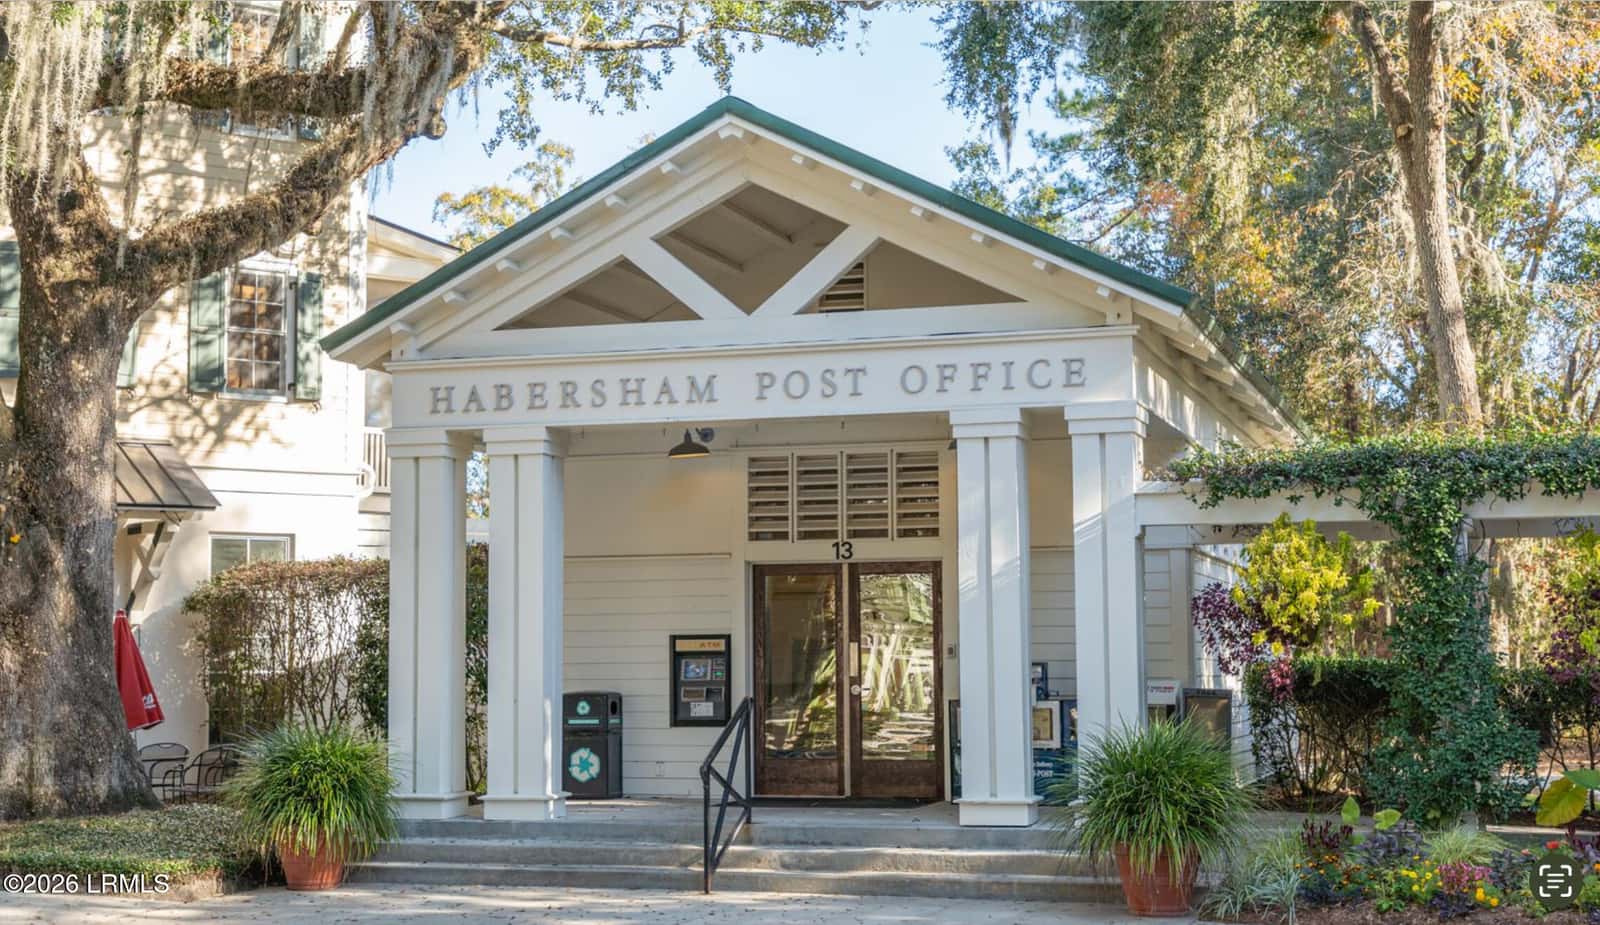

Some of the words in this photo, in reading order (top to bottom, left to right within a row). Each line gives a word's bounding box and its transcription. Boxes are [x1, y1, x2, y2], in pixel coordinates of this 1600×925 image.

[429, 374, 719, 414] HABERSHAM
[755, 366, 867, 400] POST
[900, 358, 1086, 394] OFFICE
[832, 541, 853, 560] 13
